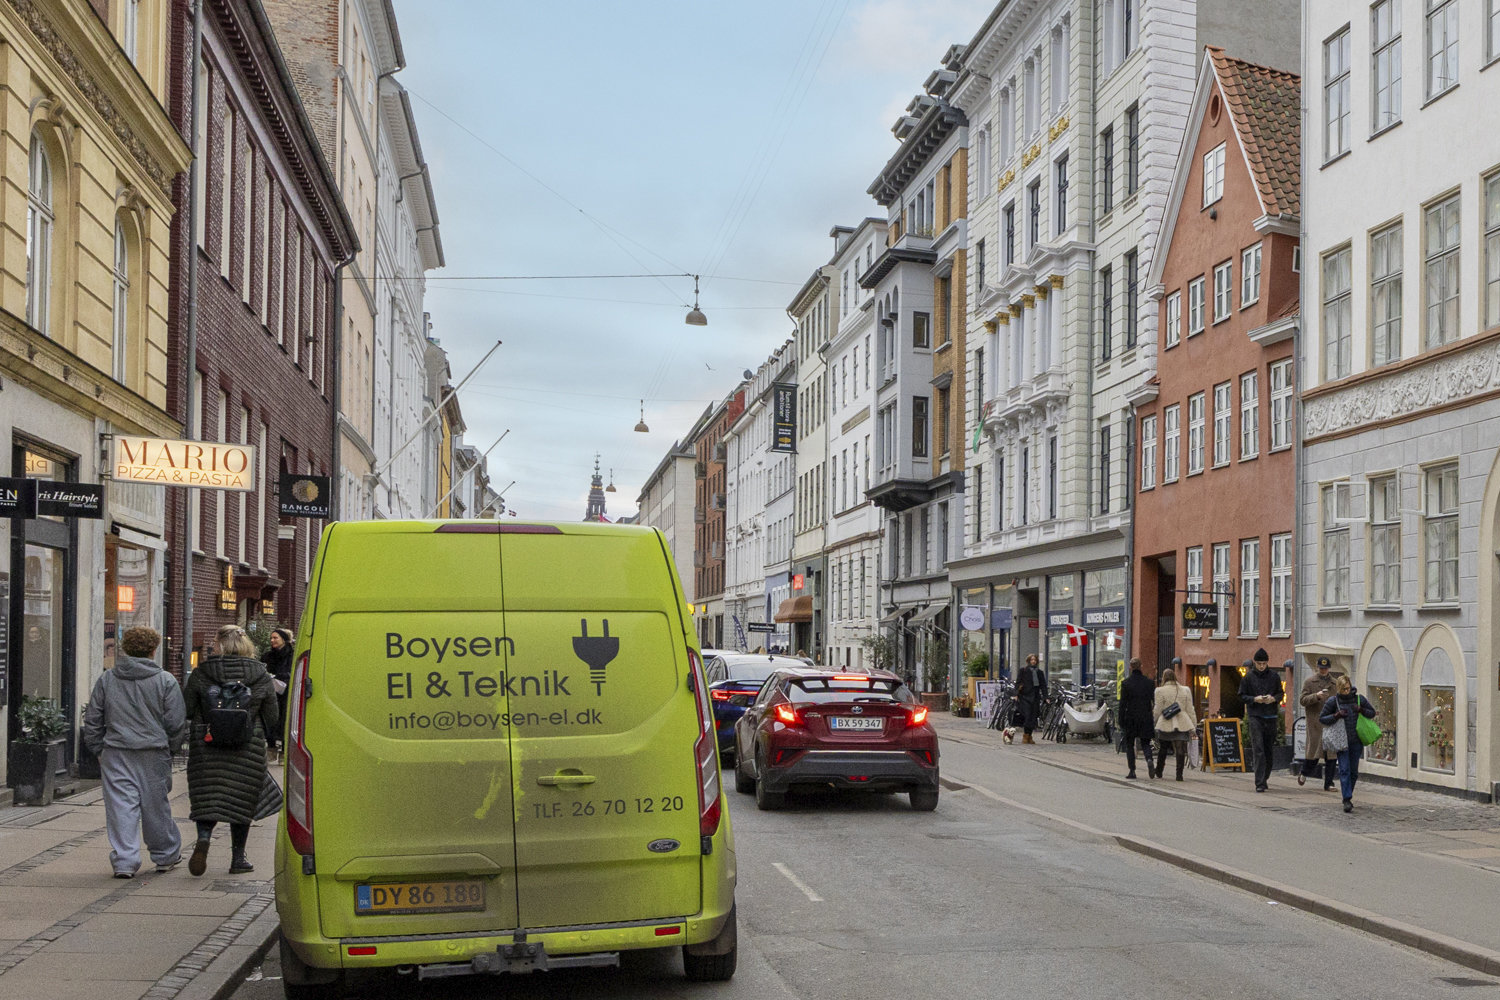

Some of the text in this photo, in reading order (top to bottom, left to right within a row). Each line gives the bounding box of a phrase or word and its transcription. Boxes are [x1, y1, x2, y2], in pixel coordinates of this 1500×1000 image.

[118, 439, 248, 473] MARIO
[117, 465, 243, 487] PIZZA & PASTA
[52, 491, 99, 504] Hairstyle
[281, 503, 328, 512] RANGOLI
[385, 632, 516, 664] Boysen
[387, 669, 572, 699] El & Teknik
[388, 708, 603, 731] info@boysen-el.dk
[837, 718, 881, 728] BX 59 347
[532, 795, 684, 819] TLF. 26 70 12 20
[372, 884, 481, 906] DY 86 180
